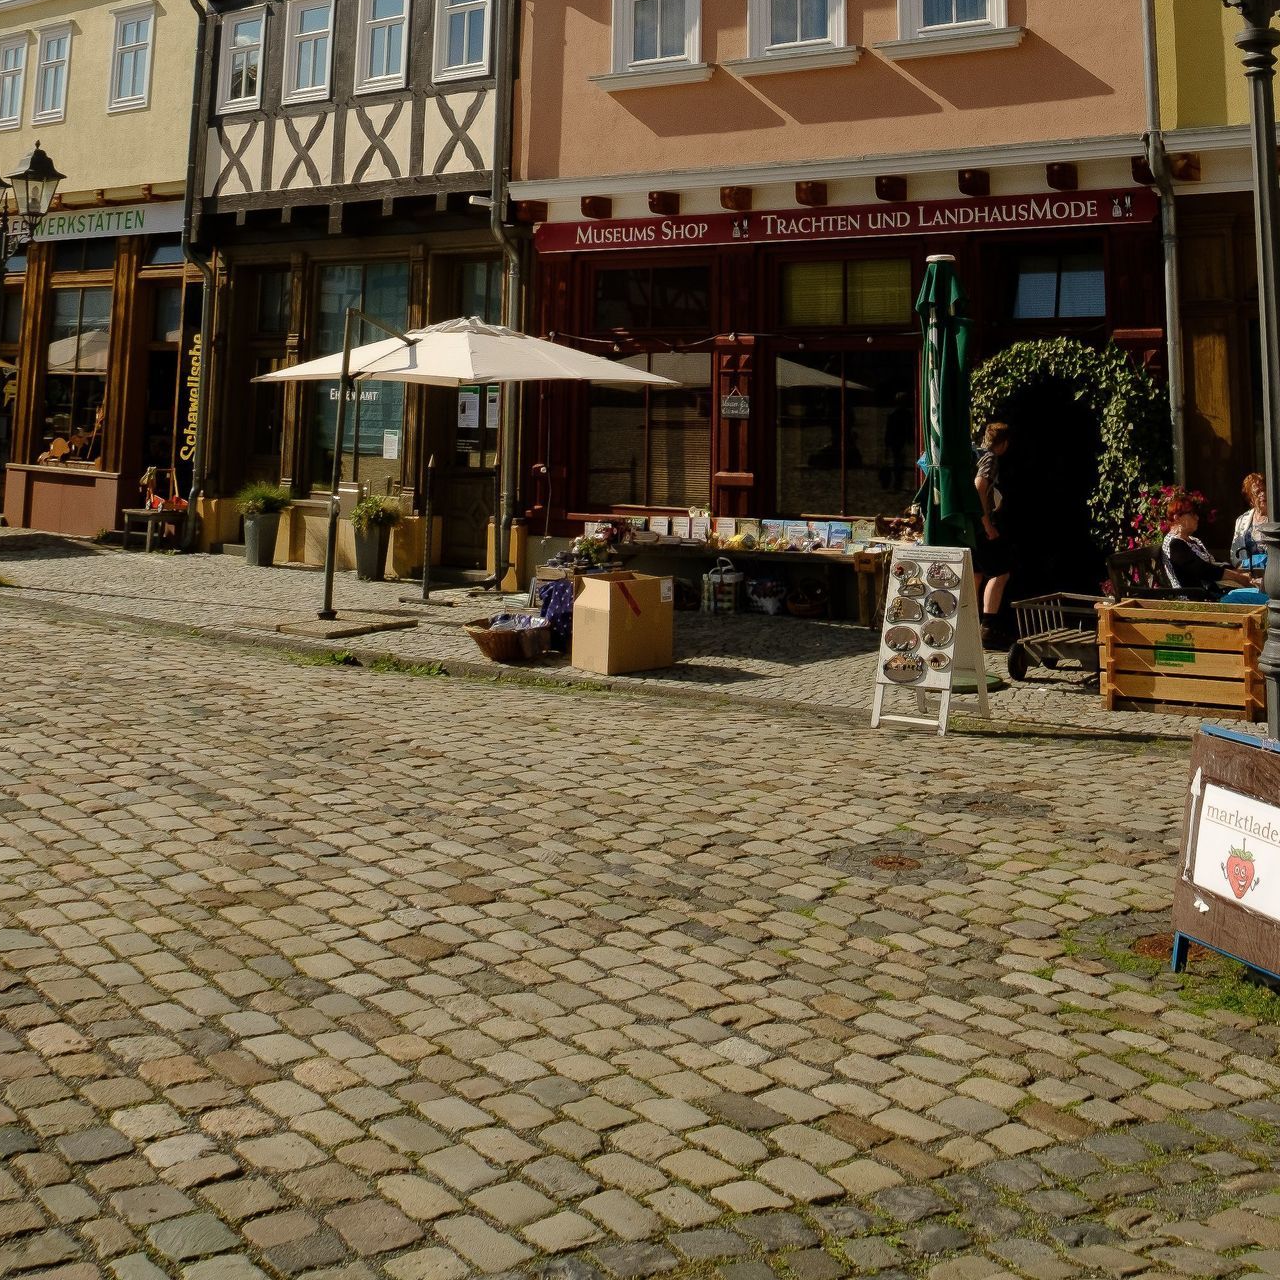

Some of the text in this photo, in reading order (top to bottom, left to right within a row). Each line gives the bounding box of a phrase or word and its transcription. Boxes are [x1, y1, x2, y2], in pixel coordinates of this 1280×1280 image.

[34, 209, 145, 237] WERKSTÄTTEN
[868, 211, 911, 230] UND
[329, 388, 378, 401] EHENAMT
